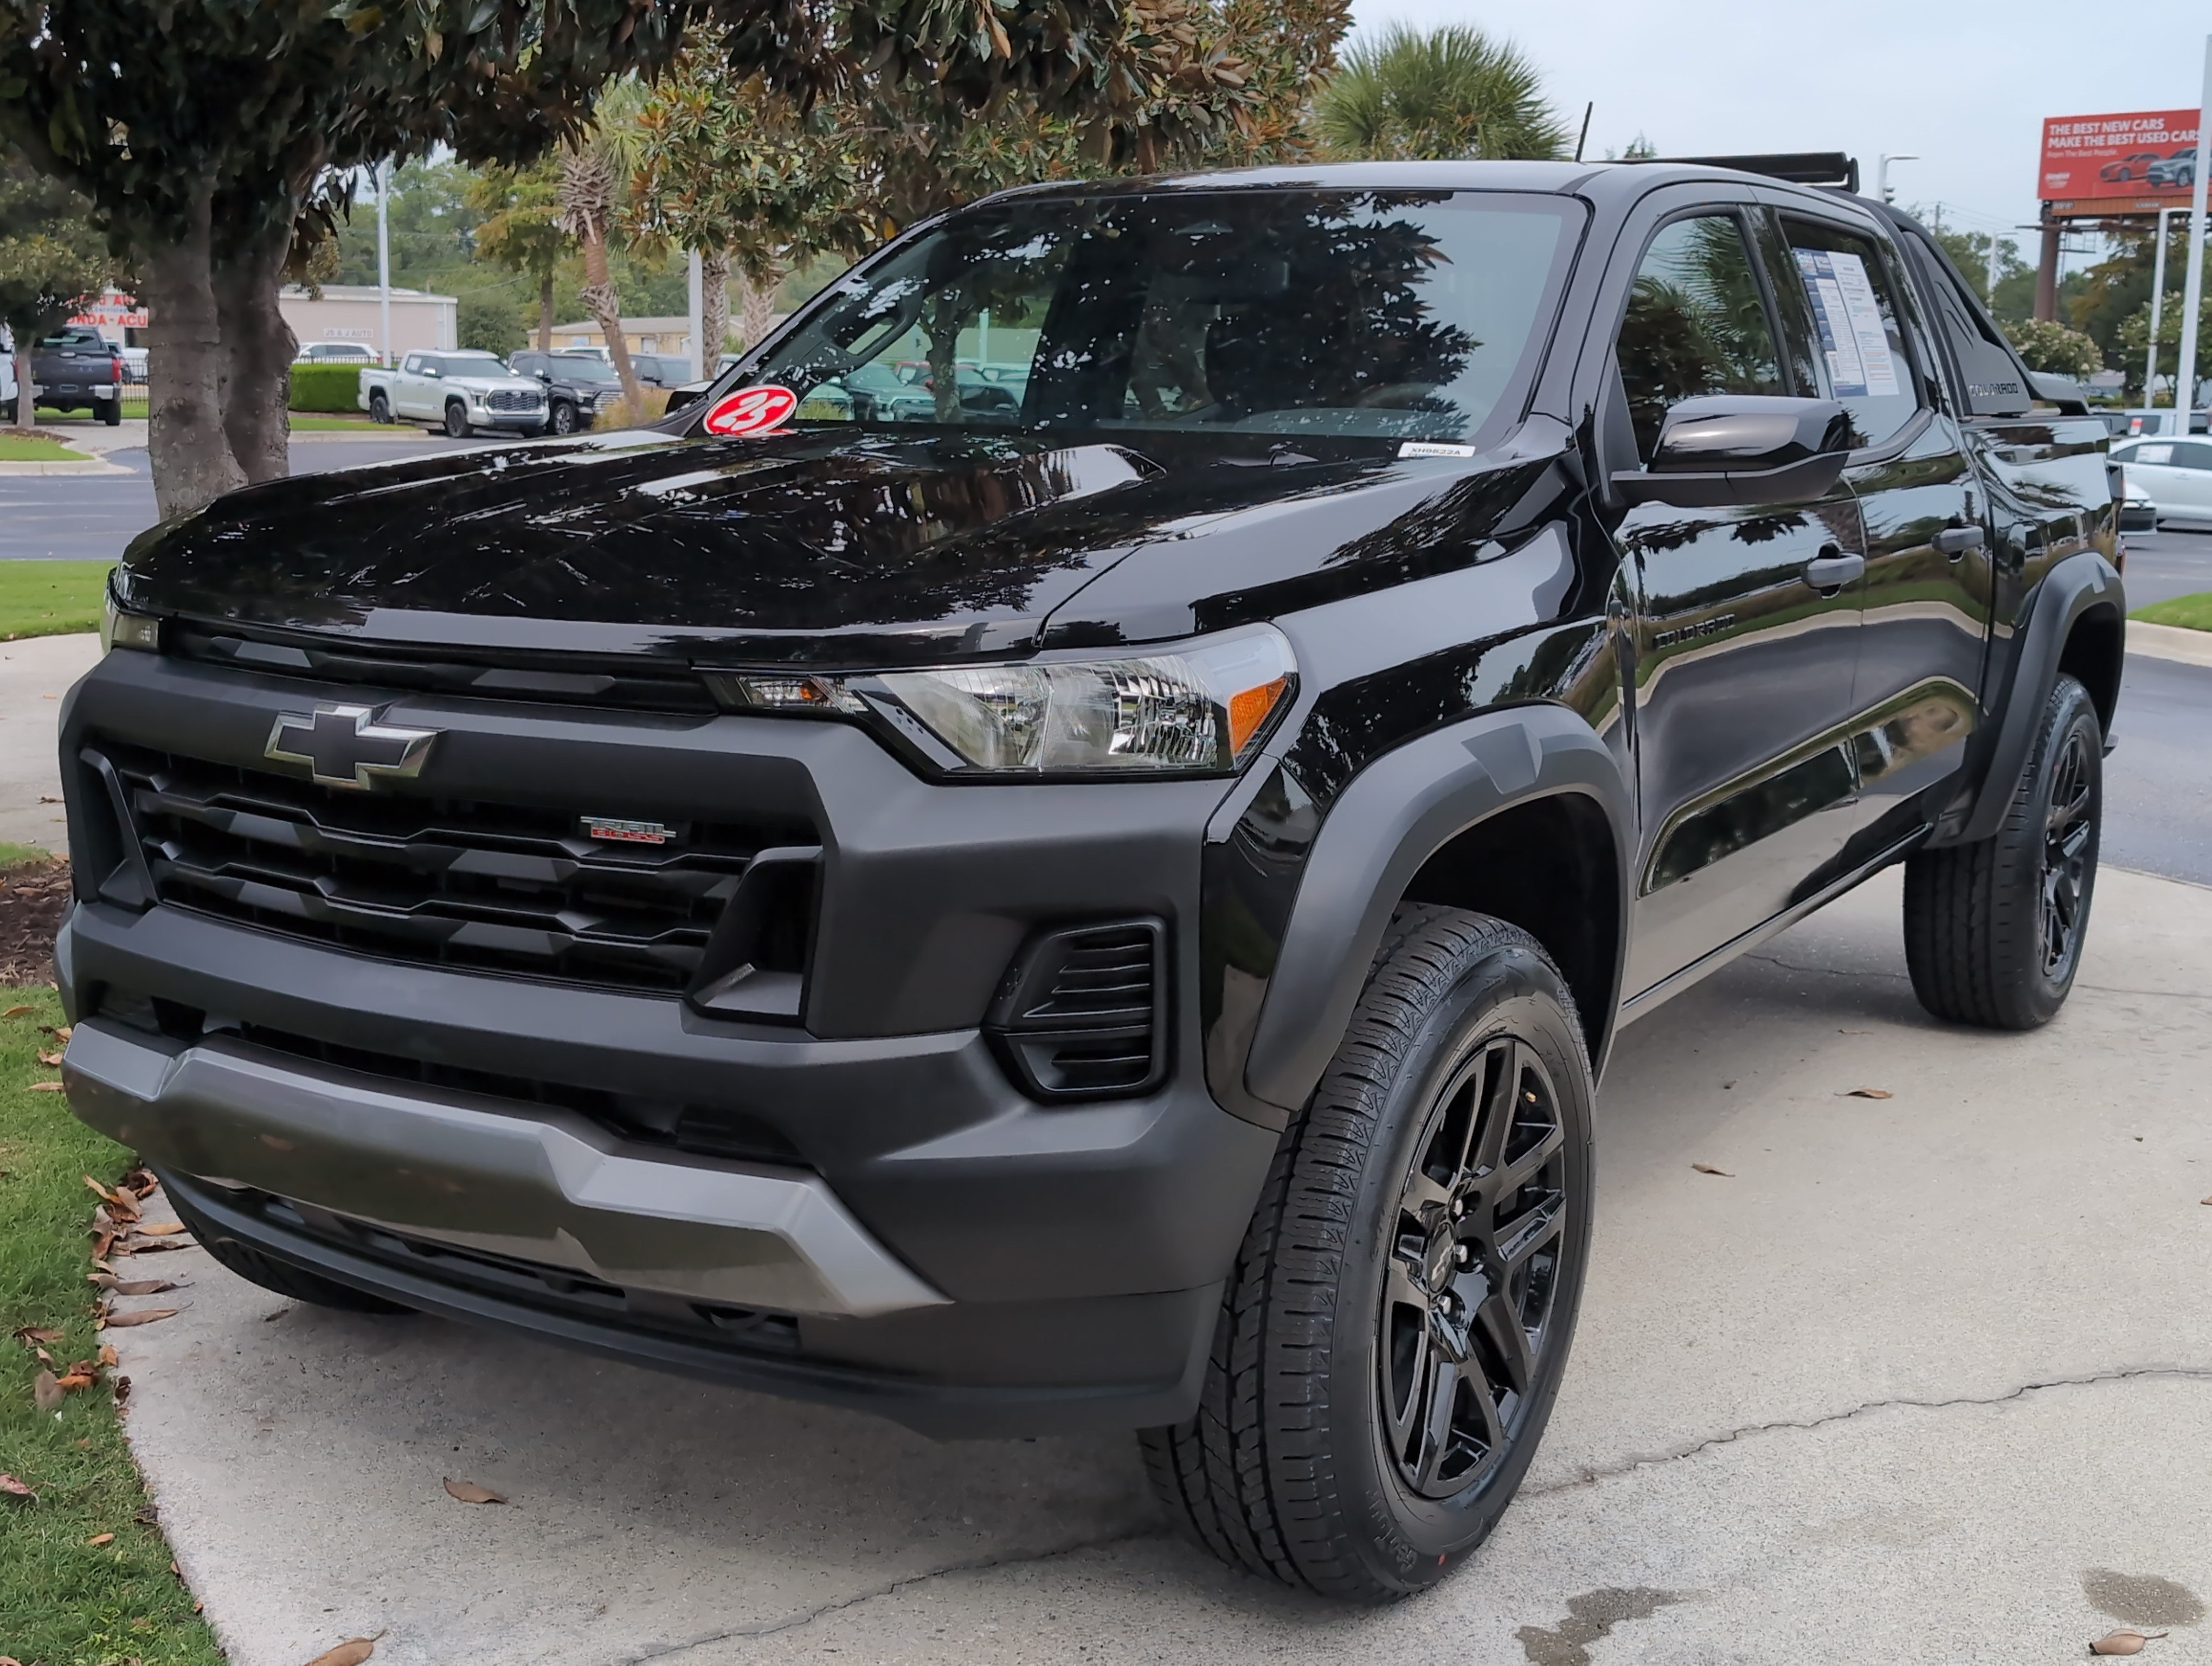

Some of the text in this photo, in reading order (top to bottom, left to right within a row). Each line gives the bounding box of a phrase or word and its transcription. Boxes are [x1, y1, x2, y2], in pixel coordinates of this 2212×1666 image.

[2050, 118, 2165, 136] THE BEST NEW CARS
[2048, 137, 2081, 148] MAKE
[2084, 135, 2105, 147] THE
[2107, 133, 2136, 145] BEST
[2138, 131, 2169, 143] USED
[352, 329, 372, 337] AUTO
[1969, 383, 2018, 397] COLORADO
